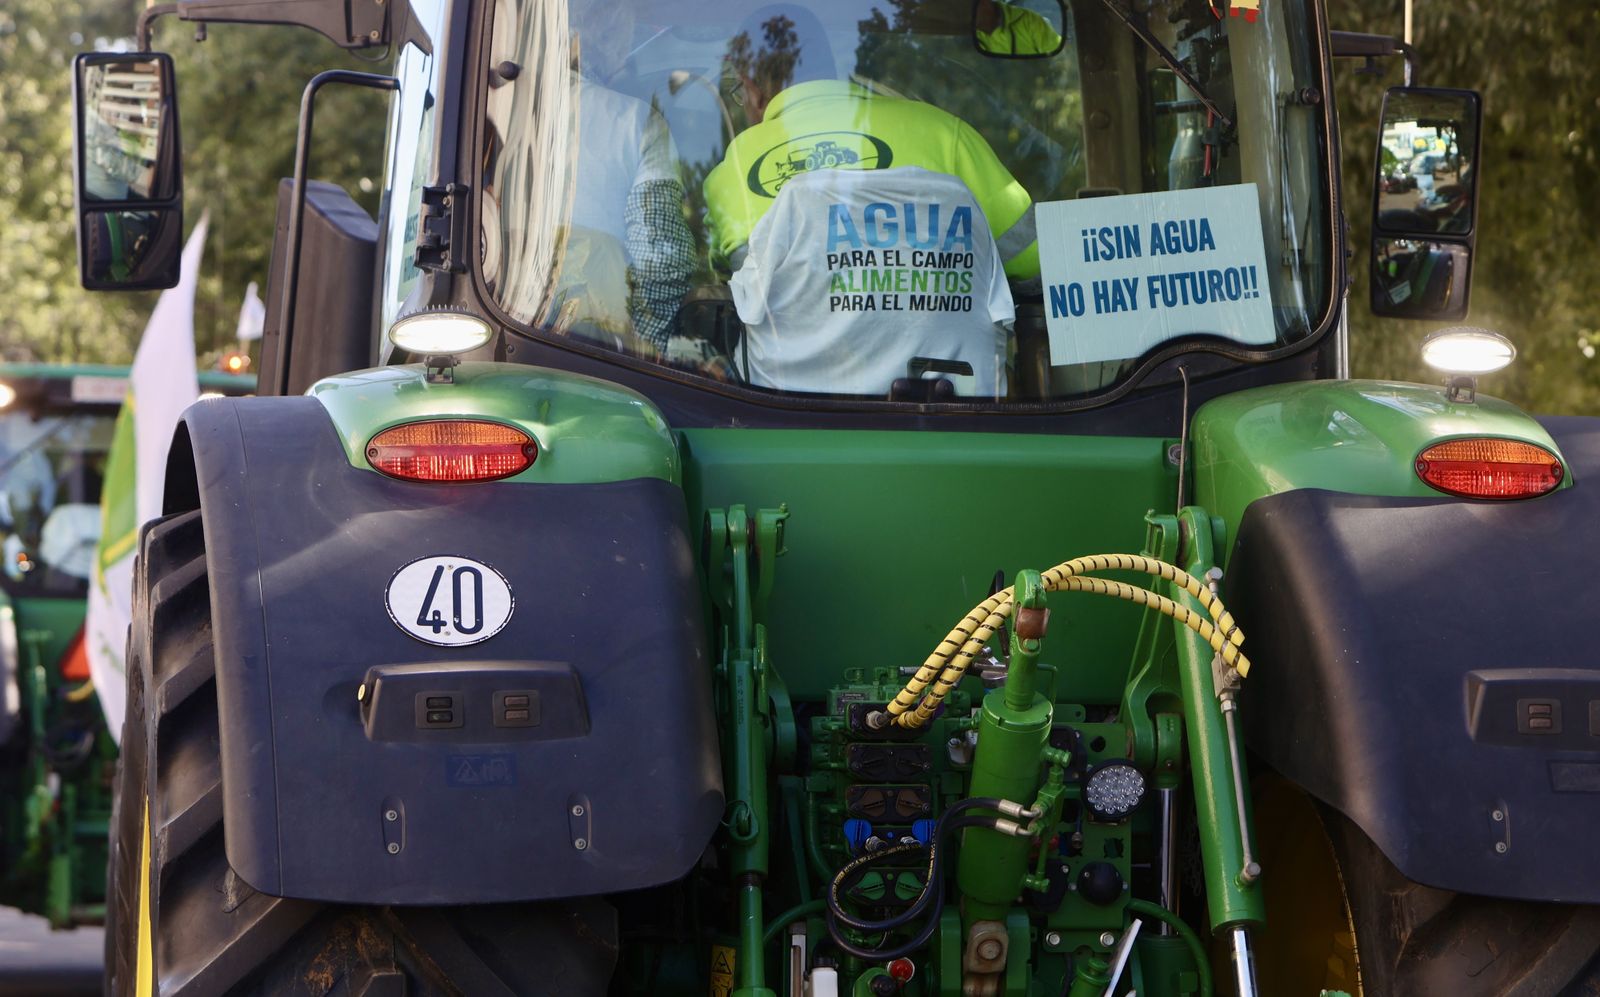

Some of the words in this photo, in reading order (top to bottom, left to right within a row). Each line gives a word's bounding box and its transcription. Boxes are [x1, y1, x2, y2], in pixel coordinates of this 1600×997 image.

[826, 202, 973, 252] AGUA
[1081, 224, 1142, 262] ¡¡SIN
[1150, 217, 1216, 256] AGUA
[827, 250, 877, 270] PARA
[883, 250, 906, 267] EL
[912, 250, 974, 269] CAMPO
[830, 269, 974, 294] ALIMENTOS
[829, 294, 876, 312] PARA
[882, 294, 903, 311] EL
[909, 294, 973, 312] MUNDO
[1049, 282, 1085, 318] NO
[1092, 276, 1139, 314] HAY
[1147, 265, 1259, 309] FUTURO!!
[416, 564, 484, 635] 40
